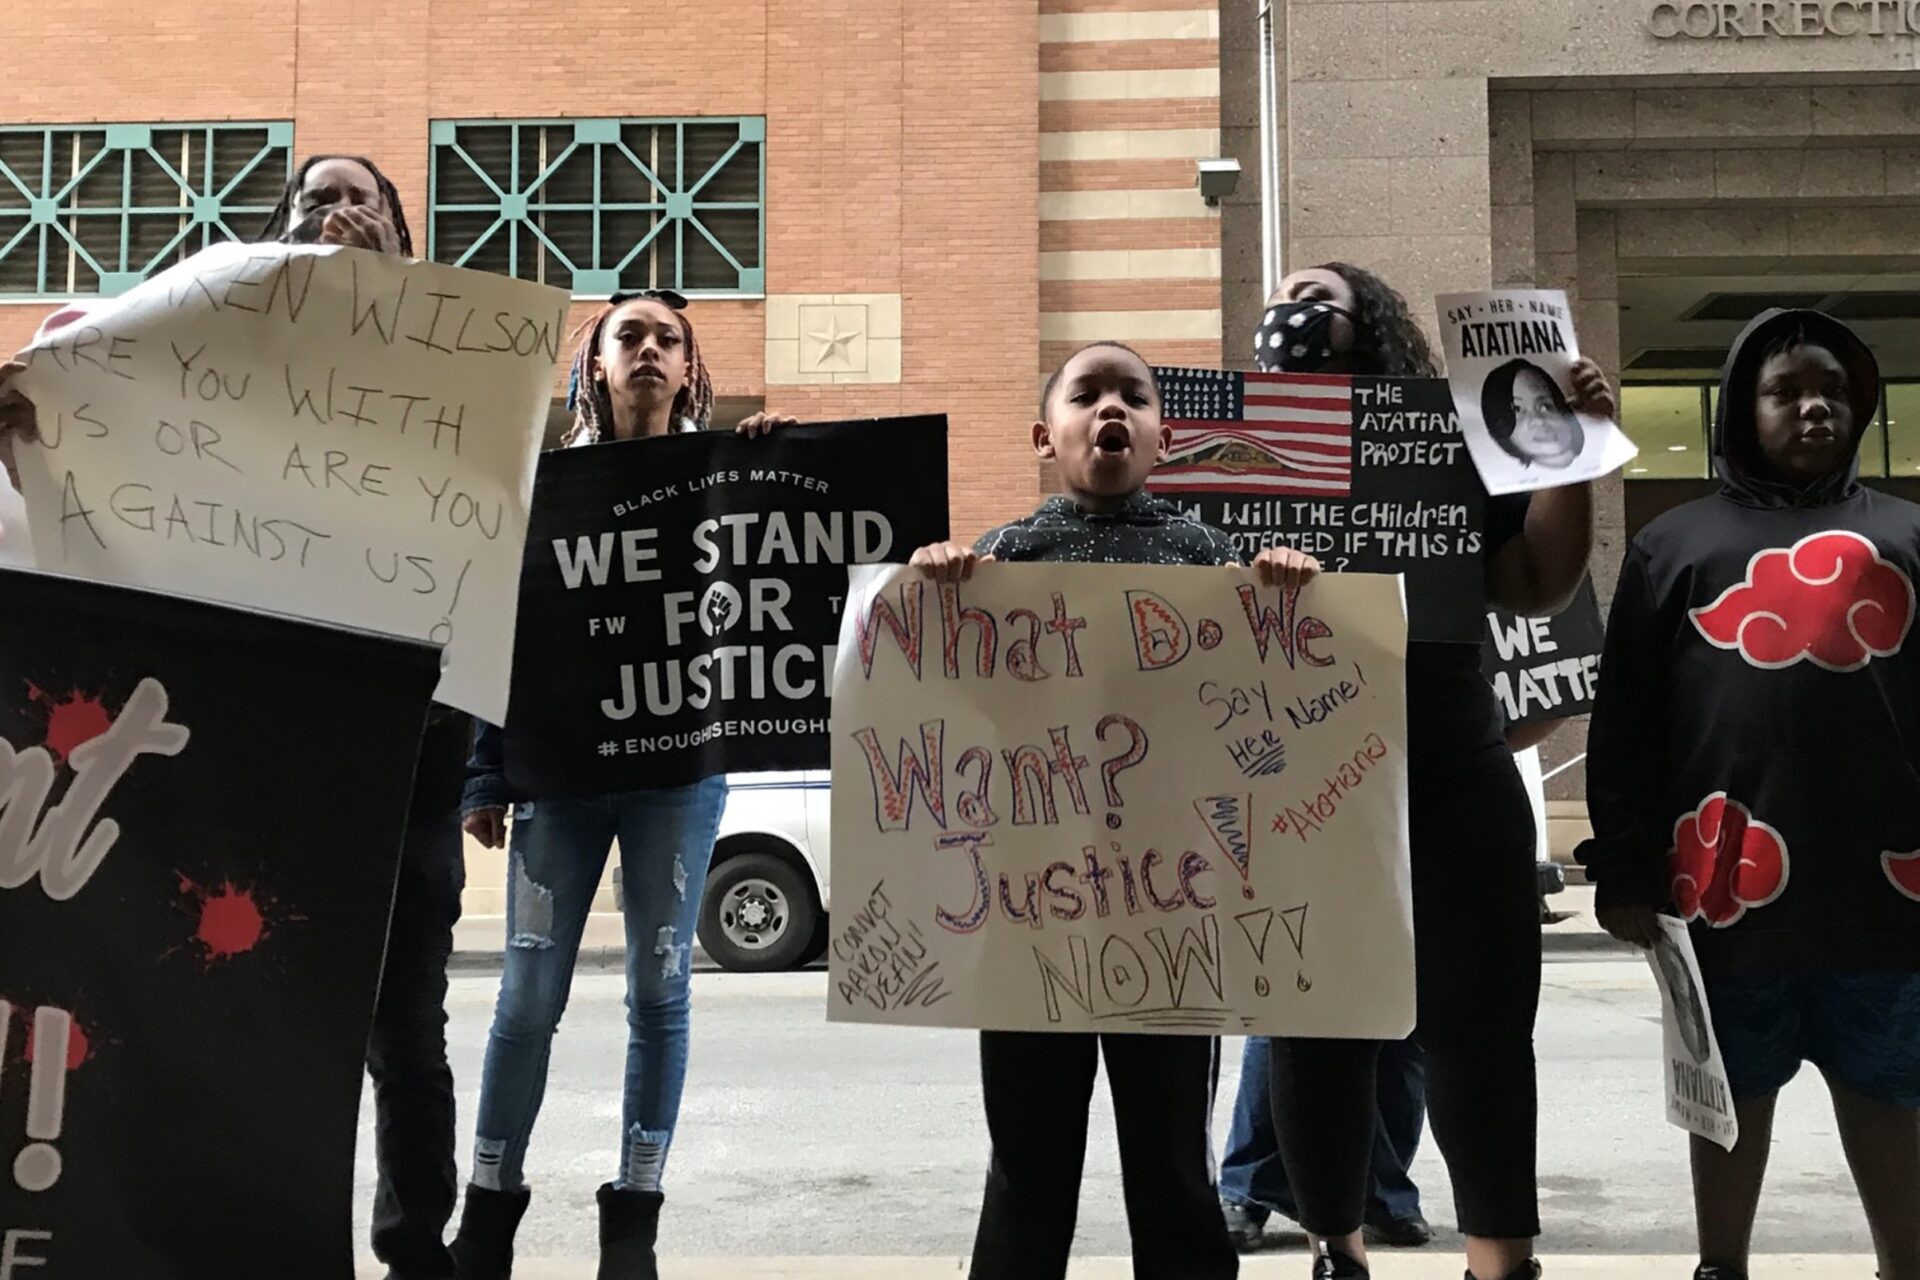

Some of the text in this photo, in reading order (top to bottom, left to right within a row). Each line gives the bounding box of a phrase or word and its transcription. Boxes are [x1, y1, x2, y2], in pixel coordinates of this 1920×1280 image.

[352, 260, 562, 363] WILSON
[1448, 299, 1563, 324] SAY HER NAME
[1462, 320, 1567, 358] ATATIANA
[29, 326, 465, 454] ARE YOU WITH
[1354, 383, 1403, 406] THE
[1359, 411, 1462, 434] ATATIAN
[38, 403, 502, 540] US OR ARE YOU
[1360, 441, 1464, 467] PROJECT
[613, 469, 830, 517] BLACK LIVES MATTER
[1291, 503, 1345, 528] THE
[59, 470, 331, 568] AGAINST
[552, 510, 893, 589] WE STAND
[1229, 531, 1334, 554] OTECTED
[1345, 532, 1367, 554] IF
[1374, 531, 1449, 558] THIS
[664, 578, 793, 647] FOR
[828, 596, 842, 614] T
[855, 578, 1336, 682] What Do We
[1486, 612, 1558, 661] WE
[1199, 680, 1273, 730] Say
[1494, 653, 1602, 721] MATTE
[852, 714, 1148, 831] Want?
